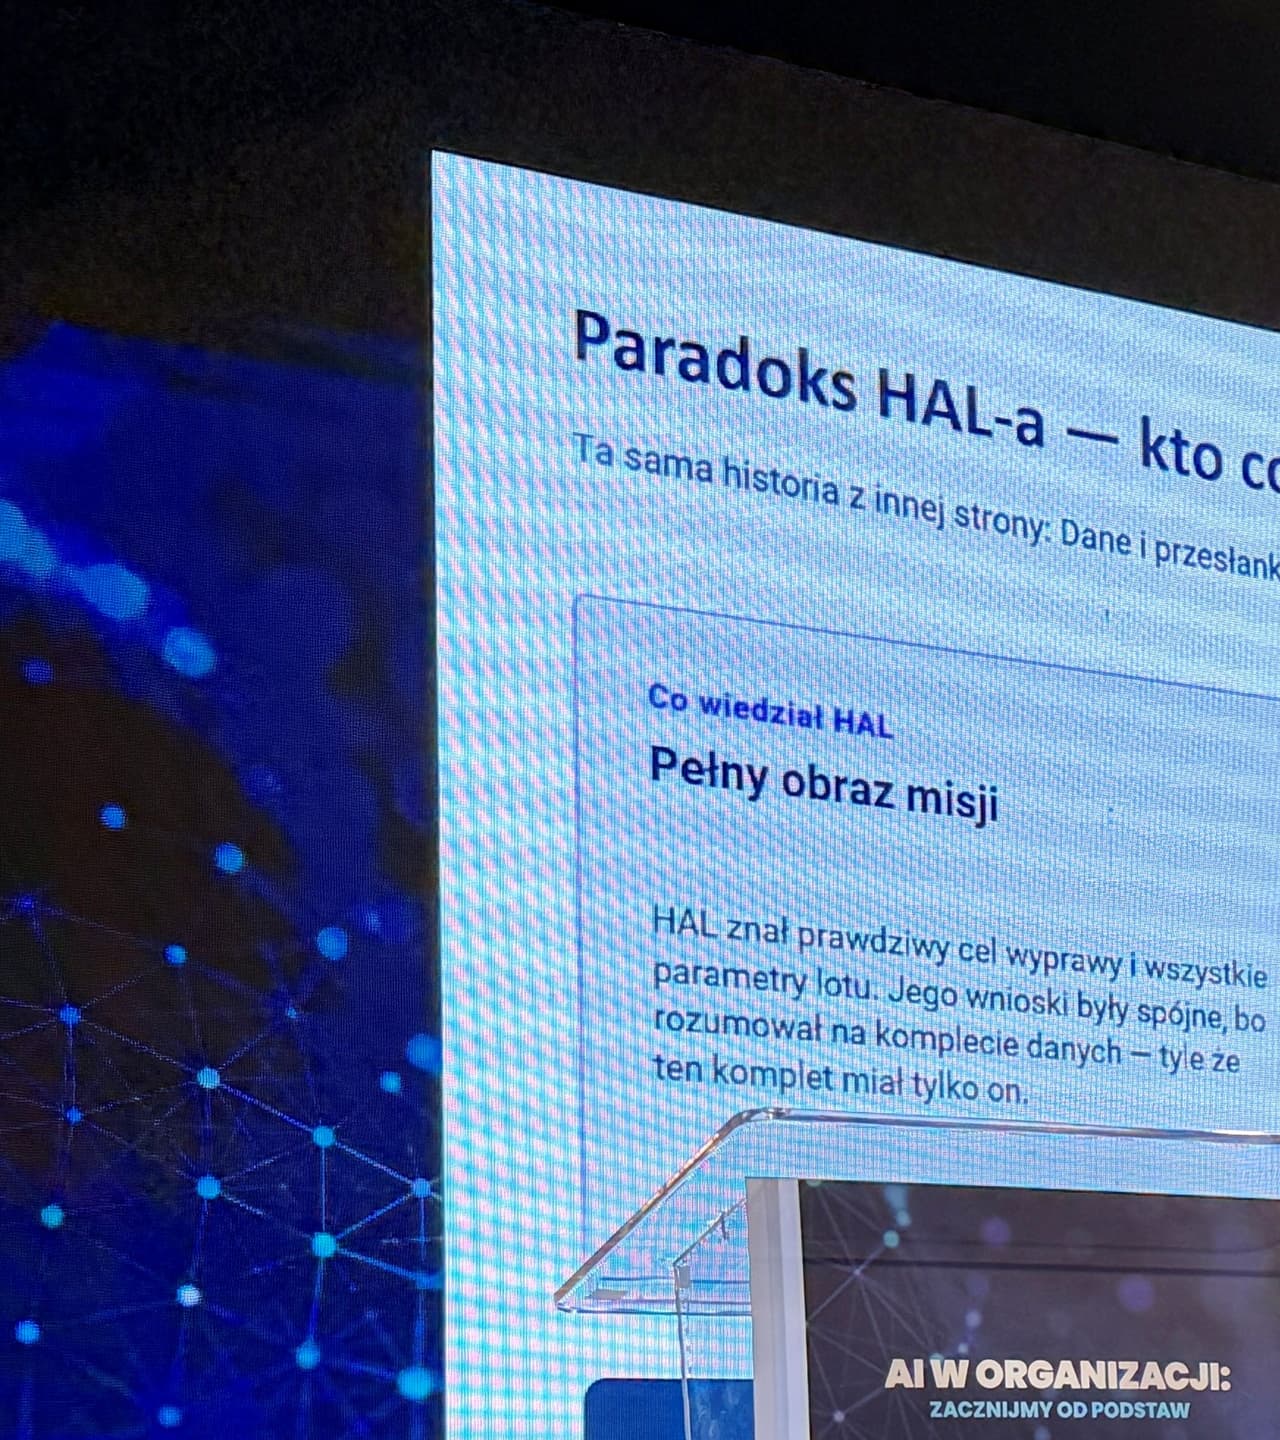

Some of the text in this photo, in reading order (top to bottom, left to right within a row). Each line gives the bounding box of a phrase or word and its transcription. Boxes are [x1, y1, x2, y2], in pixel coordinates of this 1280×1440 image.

[575, 309, 857, 411] Paradoks
[879, 367, 1044, 448] HAL-a
[1140, 414, 1223, 482] kto
[573, 431, 613, 467] Ta
[624, 449, 712, 484] sama
[724, 456, 839, 506] historia
[850, 485, 866, 510] z
[875, 483, 945, 530] innej
[954, 507, 1052, 545] strony:
[1061, 519, 1131, 557] Dane
[1140, 531, 1147, 560] i
[649, 683, 894, 739] Co wiedział HAL
[651, 745, 999, 829] Pełny obraz misji
[653, 905, 1268, 992] HAL znał prawdziwy cel wyprawy i wszystkie
[653, 962, 1266, 1036] parametry lotu. Jego wnioski były spójne, bo
[653, 1008, 823, 1043] rozumował
[831, 1021, 866, 1046] na
[876, 1018, 1018, 1062] komplecie
[1027, 1033, 1121, 1068] danych
[1159, 1043, 1204, 1073] tyle
[1211, 1046, 1240, 1073] że
[653, 1054, 1028, 1106] ten komplet miał tylko on.
[884, 1358, 1232, 1392] AI W ORGANIZACJI:
[929, 1400, 1191, 1419] ZACZNIJMY OD PODSTAW
